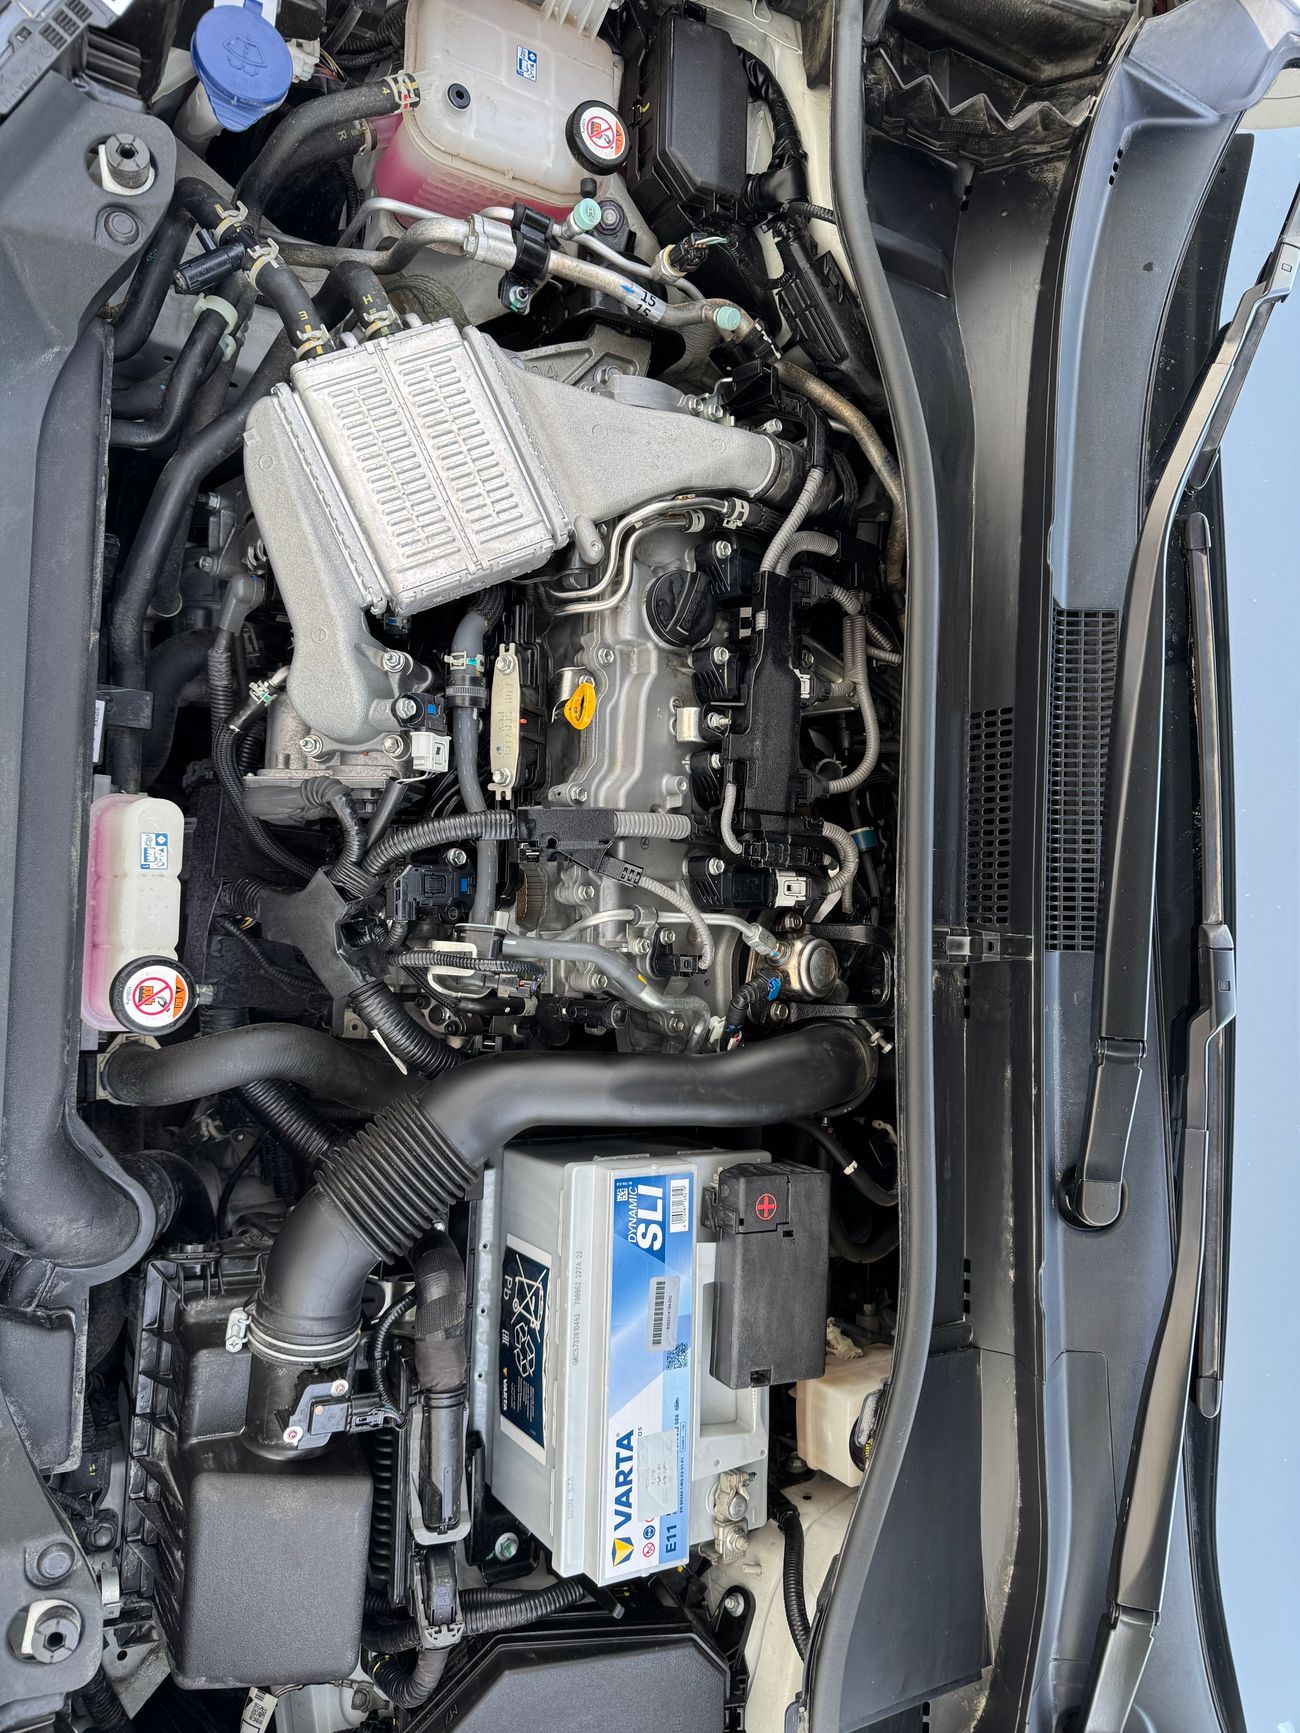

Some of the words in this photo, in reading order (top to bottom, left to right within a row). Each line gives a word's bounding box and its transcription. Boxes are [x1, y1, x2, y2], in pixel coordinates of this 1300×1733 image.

[337, 130, 347, 141] R
[362, 294, 374, 305] H
[640, 290, 657, 307] 15
[628, 1186, 638, 1242] DYNAMIC
[637, 1184, 663, 1250] SLI
[503, 1275, 513, 1300] Pb
[614, 1429, 634, 1532] VARTA
[665, 1525, 677, 1553] E11
